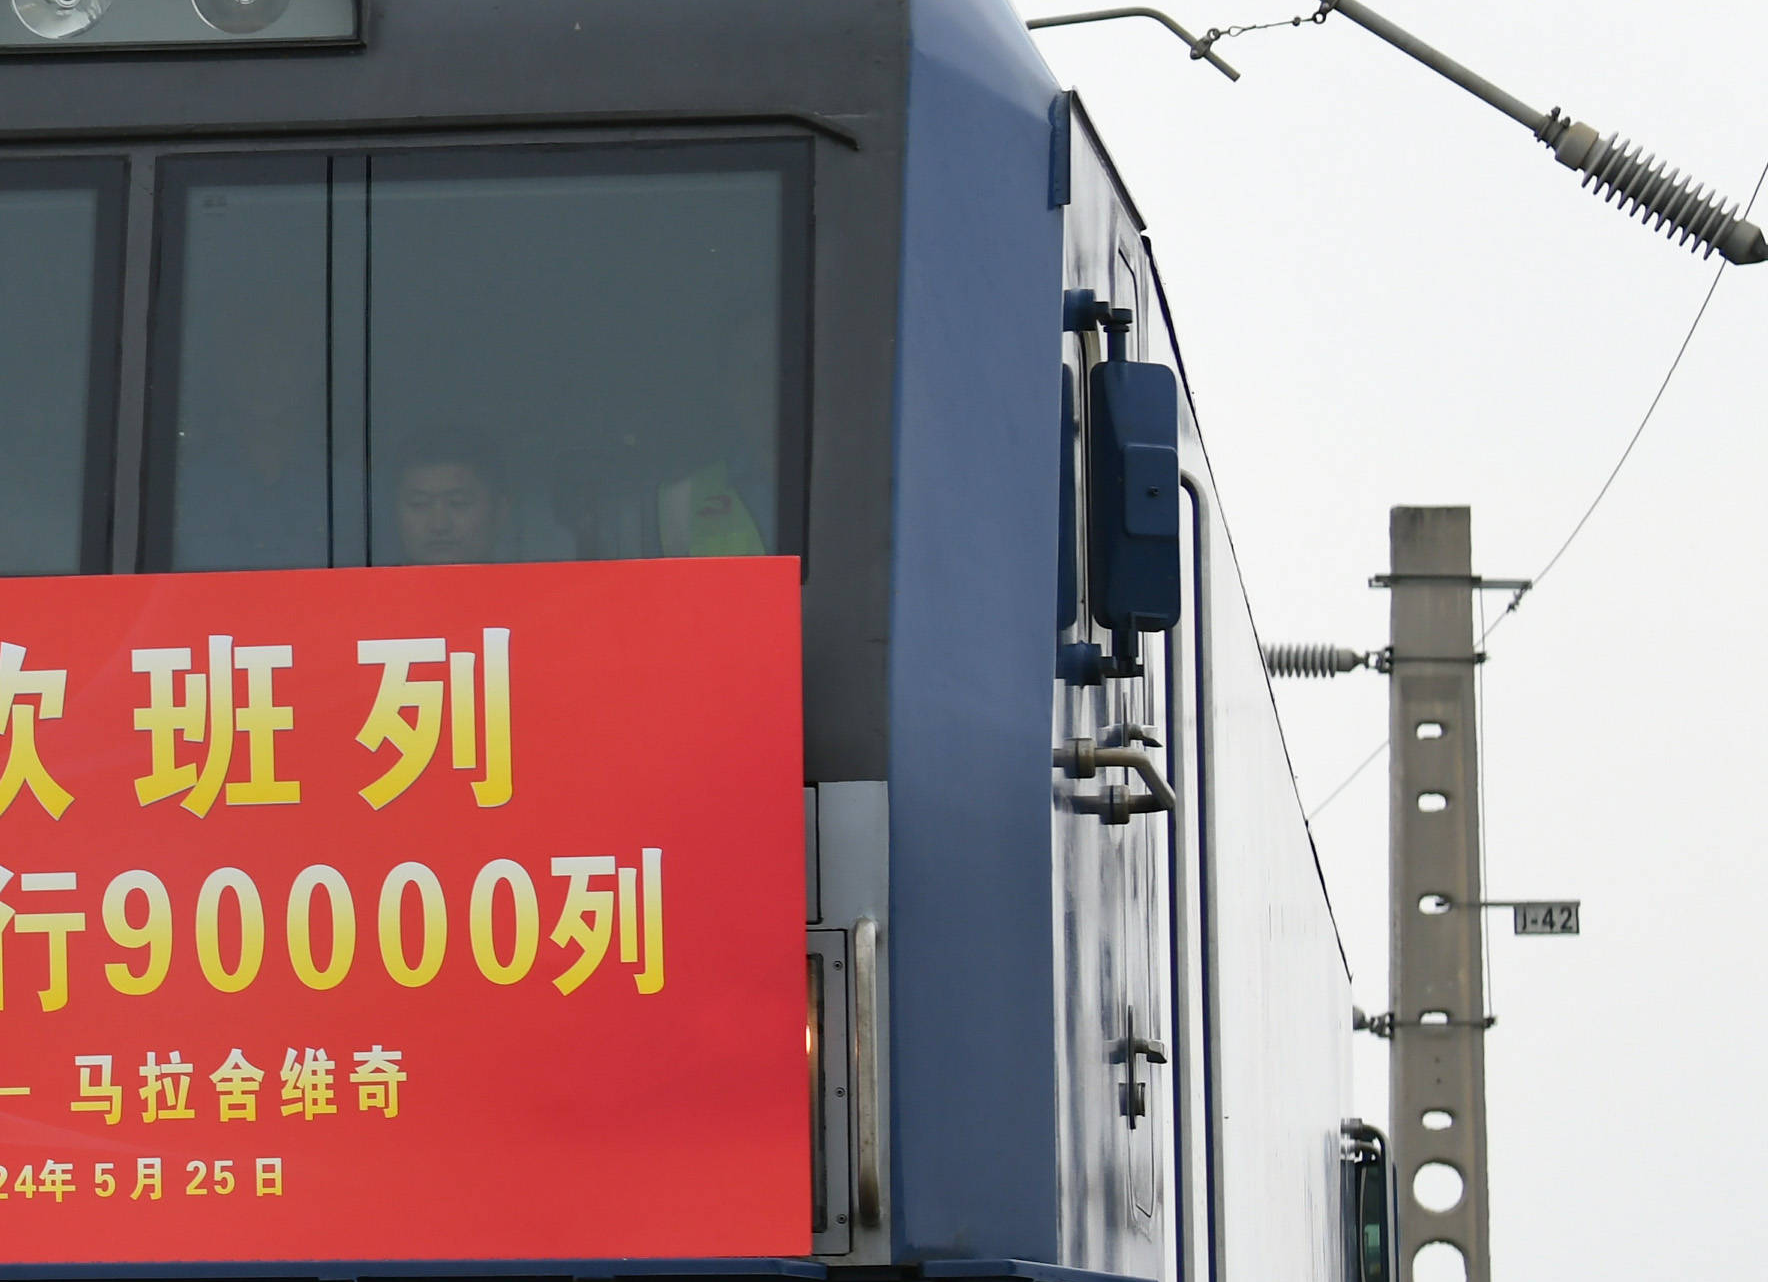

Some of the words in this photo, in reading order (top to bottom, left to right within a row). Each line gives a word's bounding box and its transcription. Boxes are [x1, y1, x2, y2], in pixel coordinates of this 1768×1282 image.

[71, 1045, 407, 1126] 马拉舍维奇
